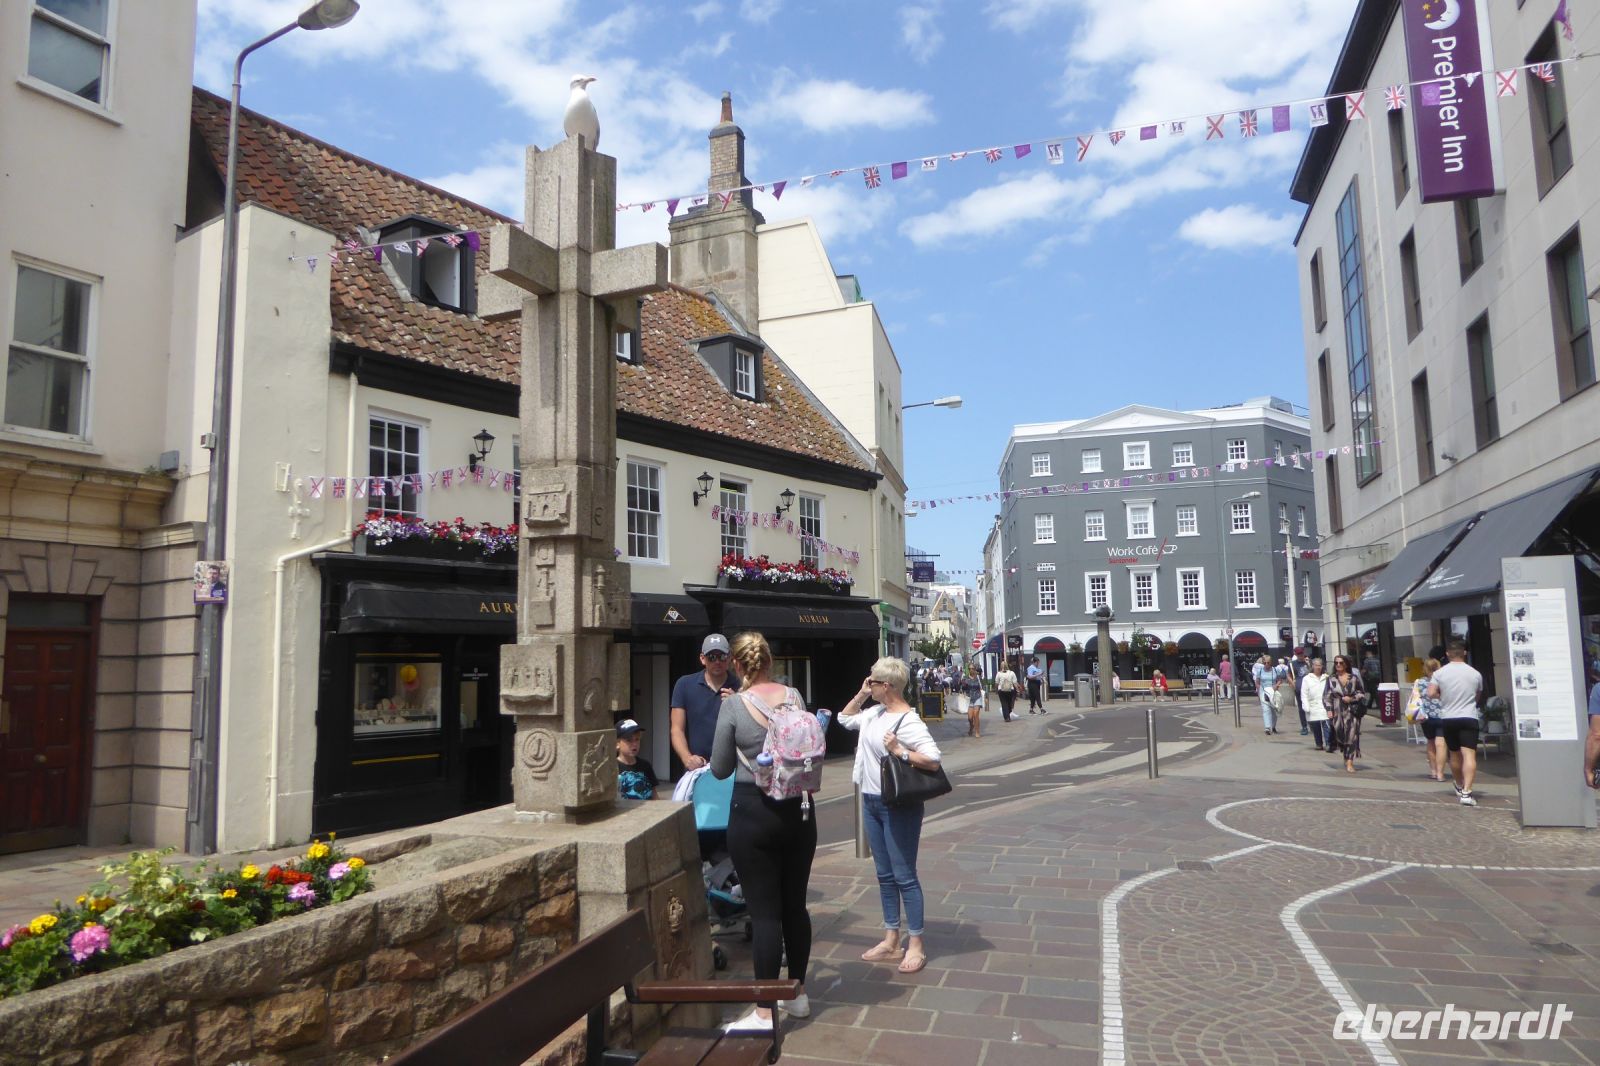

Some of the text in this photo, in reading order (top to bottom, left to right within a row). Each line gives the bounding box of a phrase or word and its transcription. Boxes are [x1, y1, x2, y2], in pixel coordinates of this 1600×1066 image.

[1431, 36, 1467, 173] Premier Inn
[1107, 545, 1159, 557] Work Café
[799, 615, 830, 624] AURUM
